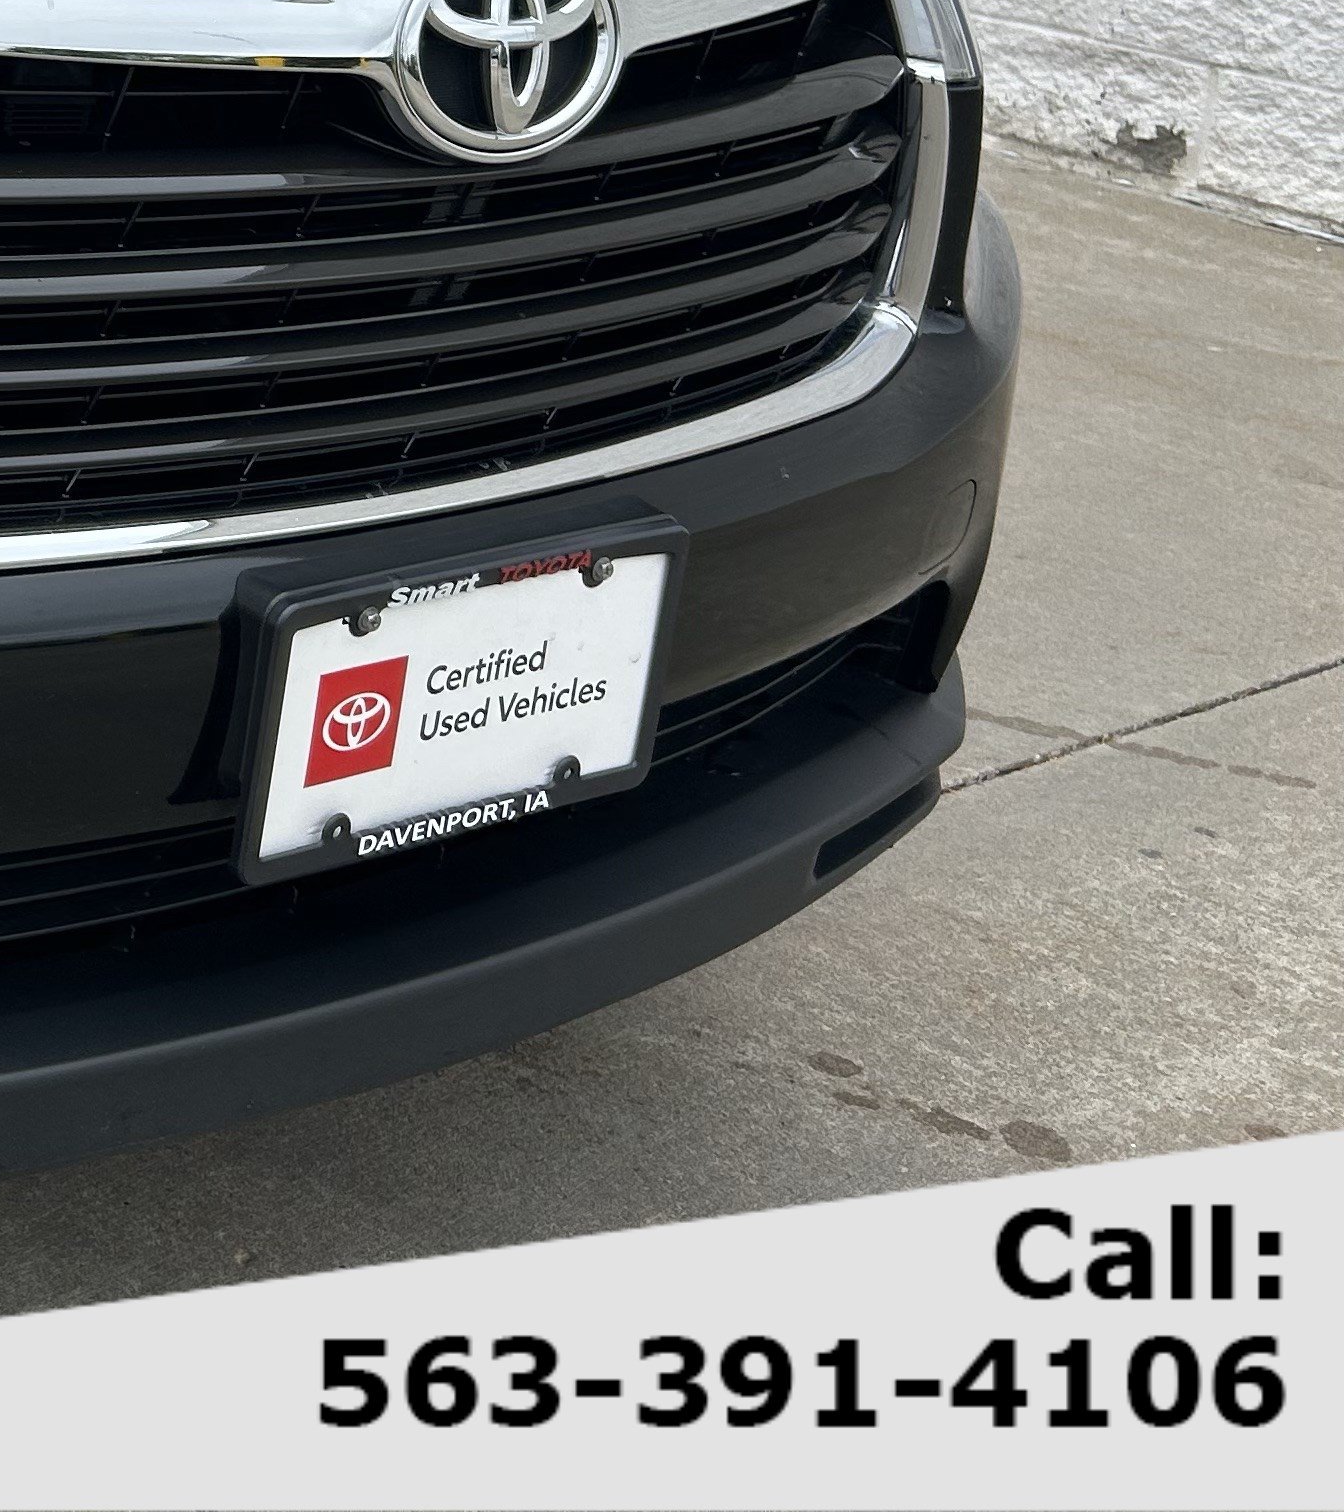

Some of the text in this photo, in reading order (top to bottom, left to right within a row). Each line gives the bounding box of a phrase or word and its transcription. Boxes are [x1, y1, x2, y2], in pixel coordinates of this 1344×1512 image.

[386, 548, 593, 609] Smart TOYOTA
[426, 640, 548, 695] Certified
[419, 678, 606, 741] Used Vehicles
[357, 790, 550, 856] DAVENPORT, IA
